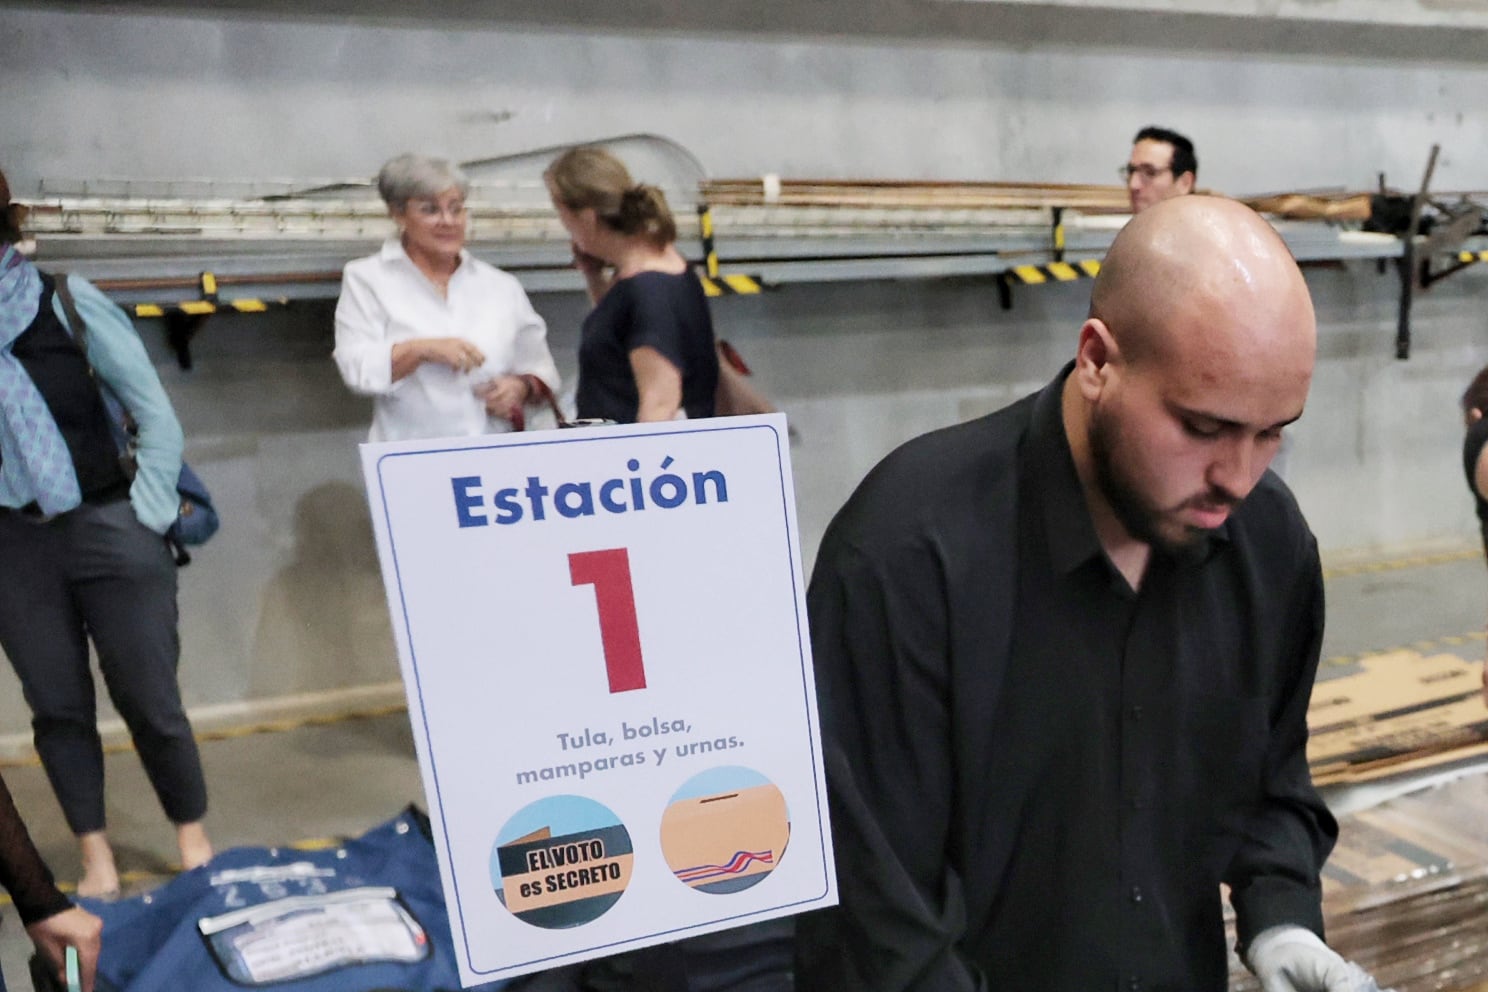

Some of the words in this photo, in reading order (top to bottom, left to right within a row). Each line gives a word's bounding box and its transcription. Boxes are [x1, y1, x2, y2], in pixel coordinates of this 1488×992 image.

[450, 455, 729, 528] Estación
[567, 547, 647, 694] 1
[556, 727, 614, 751] Tula,
[622, 716, 692, 741] bolsa,
[516, 751, 646, 785] mamparas
[653, 748, 667, 766] y
[675, 733, 745, 757] urnas.
[529, 850, 551, 872] EL
[551, 839, 604, 868] VOTO
[520, 881, 542, 898] es
[546, 862, 621, 893] SECRETO
